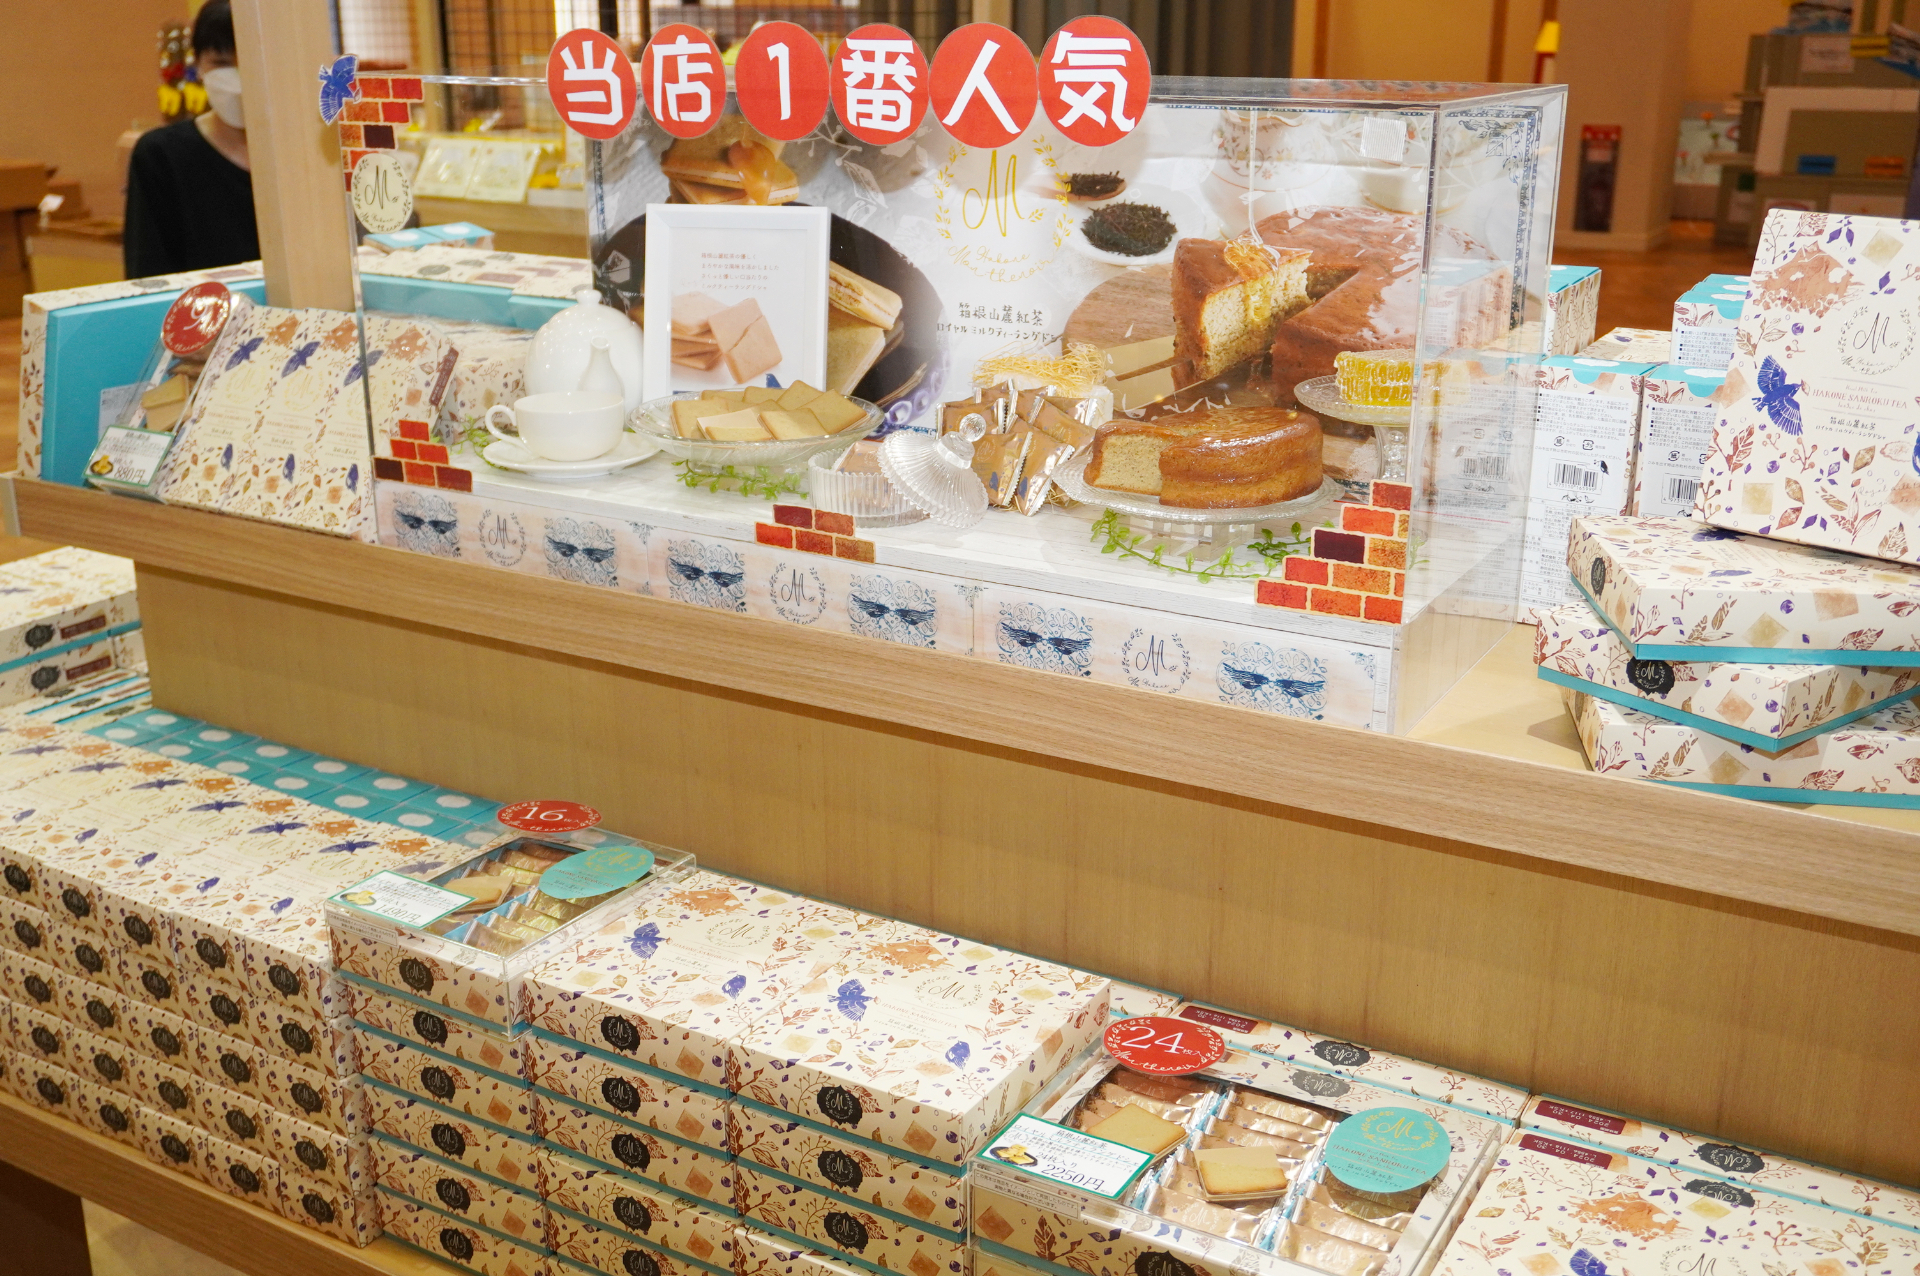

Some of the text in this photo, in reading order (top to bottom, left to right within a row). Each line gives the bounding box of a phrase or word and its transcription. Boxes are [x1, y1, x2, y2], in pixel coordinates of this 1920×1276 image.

[561, 31, 1135, 133] 当店1番人気
[364, 165, 391, 209] M
[962, 149, 1025, 237] M
[958, 302, 1044, 327] 箱根山麓紅茶
[1853, 312, 1890, 354] M
[488, 515, 511, 549] M
[781, 569, 807, 606] M
[1136, 635, 1167, 676] M
[1641, 661, 1656, 680] M
[1376, 1117, 1415, 1139] M
[1041, 1164, 1105, 1190] 2250円
[1678, 1253, 1717, 1276] M
